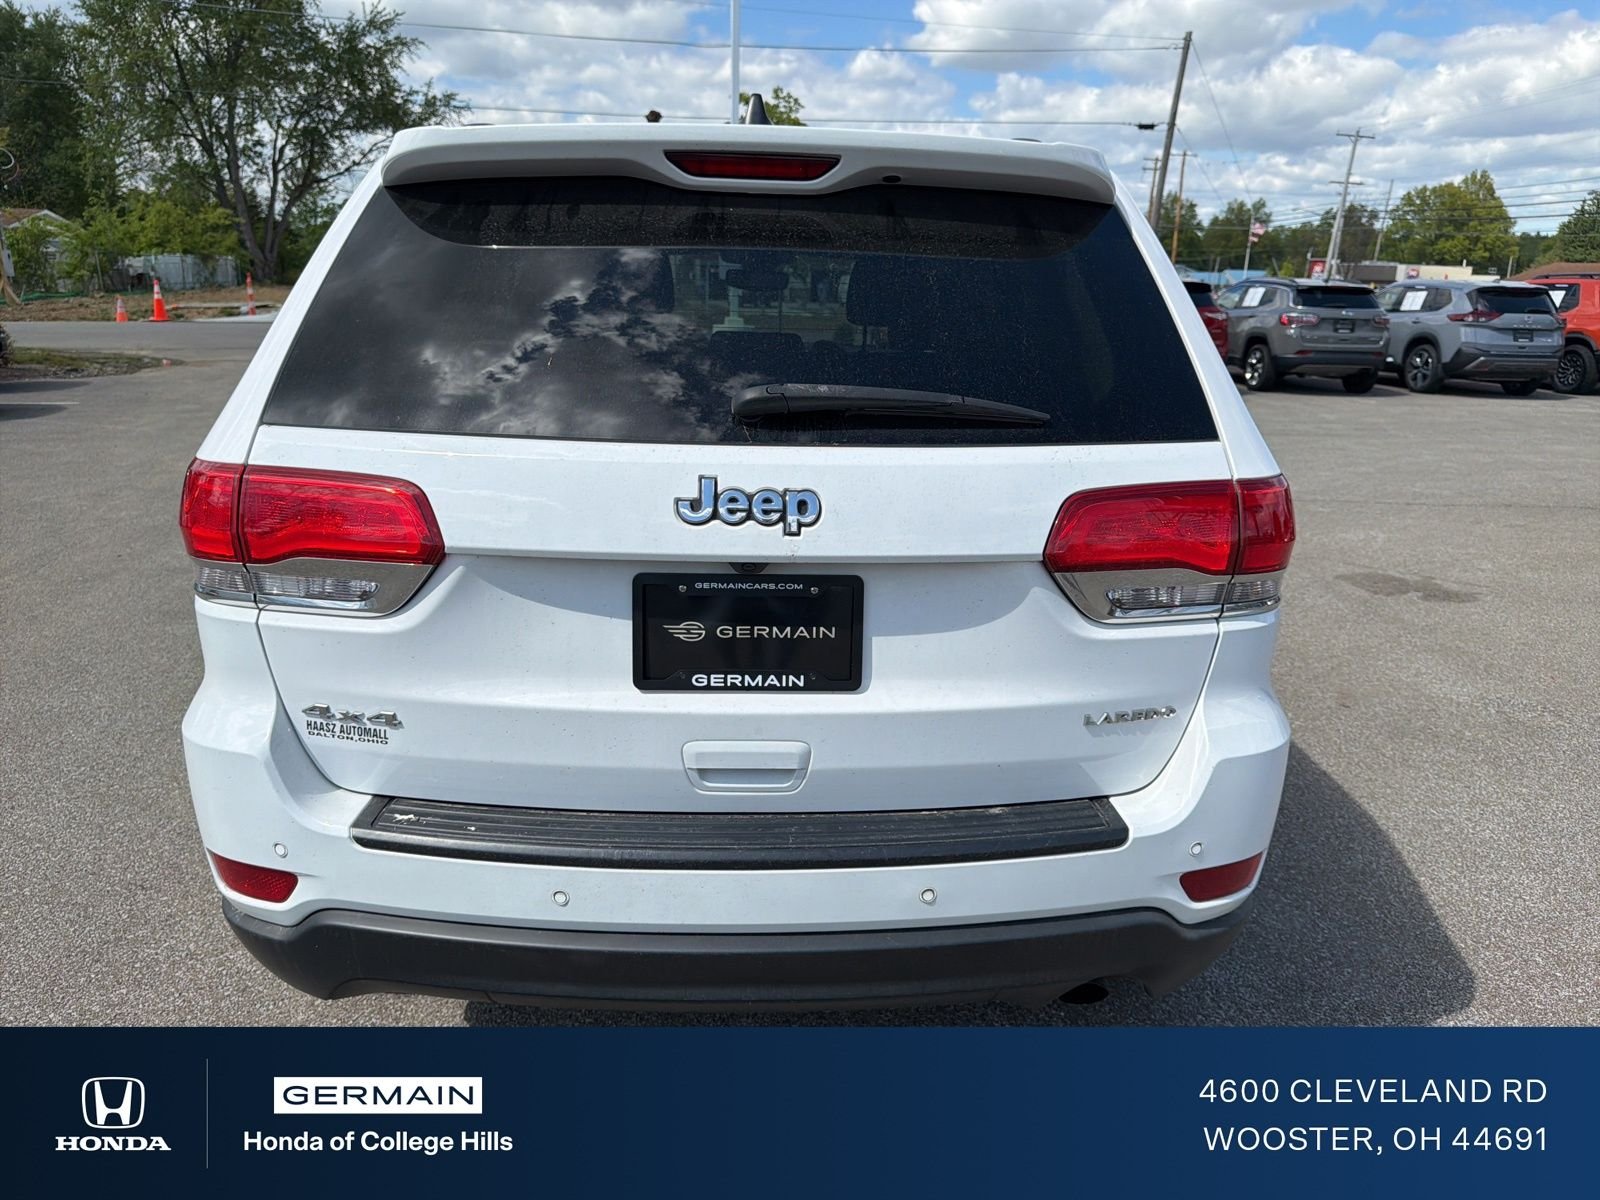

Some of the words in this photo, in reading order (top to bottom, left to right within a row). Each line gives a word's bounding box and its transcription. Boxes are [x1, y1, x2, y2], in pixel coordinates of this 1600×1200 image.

[674, 475, 822, 537] Jeep
[694, 582, 804, 591] GERMAINCARS.COM
[716, 625, 836, 639] GERMAIN
[691, 674, 805, 688] GERMAIN
[1083, 705, 1177, 727] LAREDO
[306, 719, 337, 734] HAASZ
[340, 724, 389, 740] AUTOMALL
